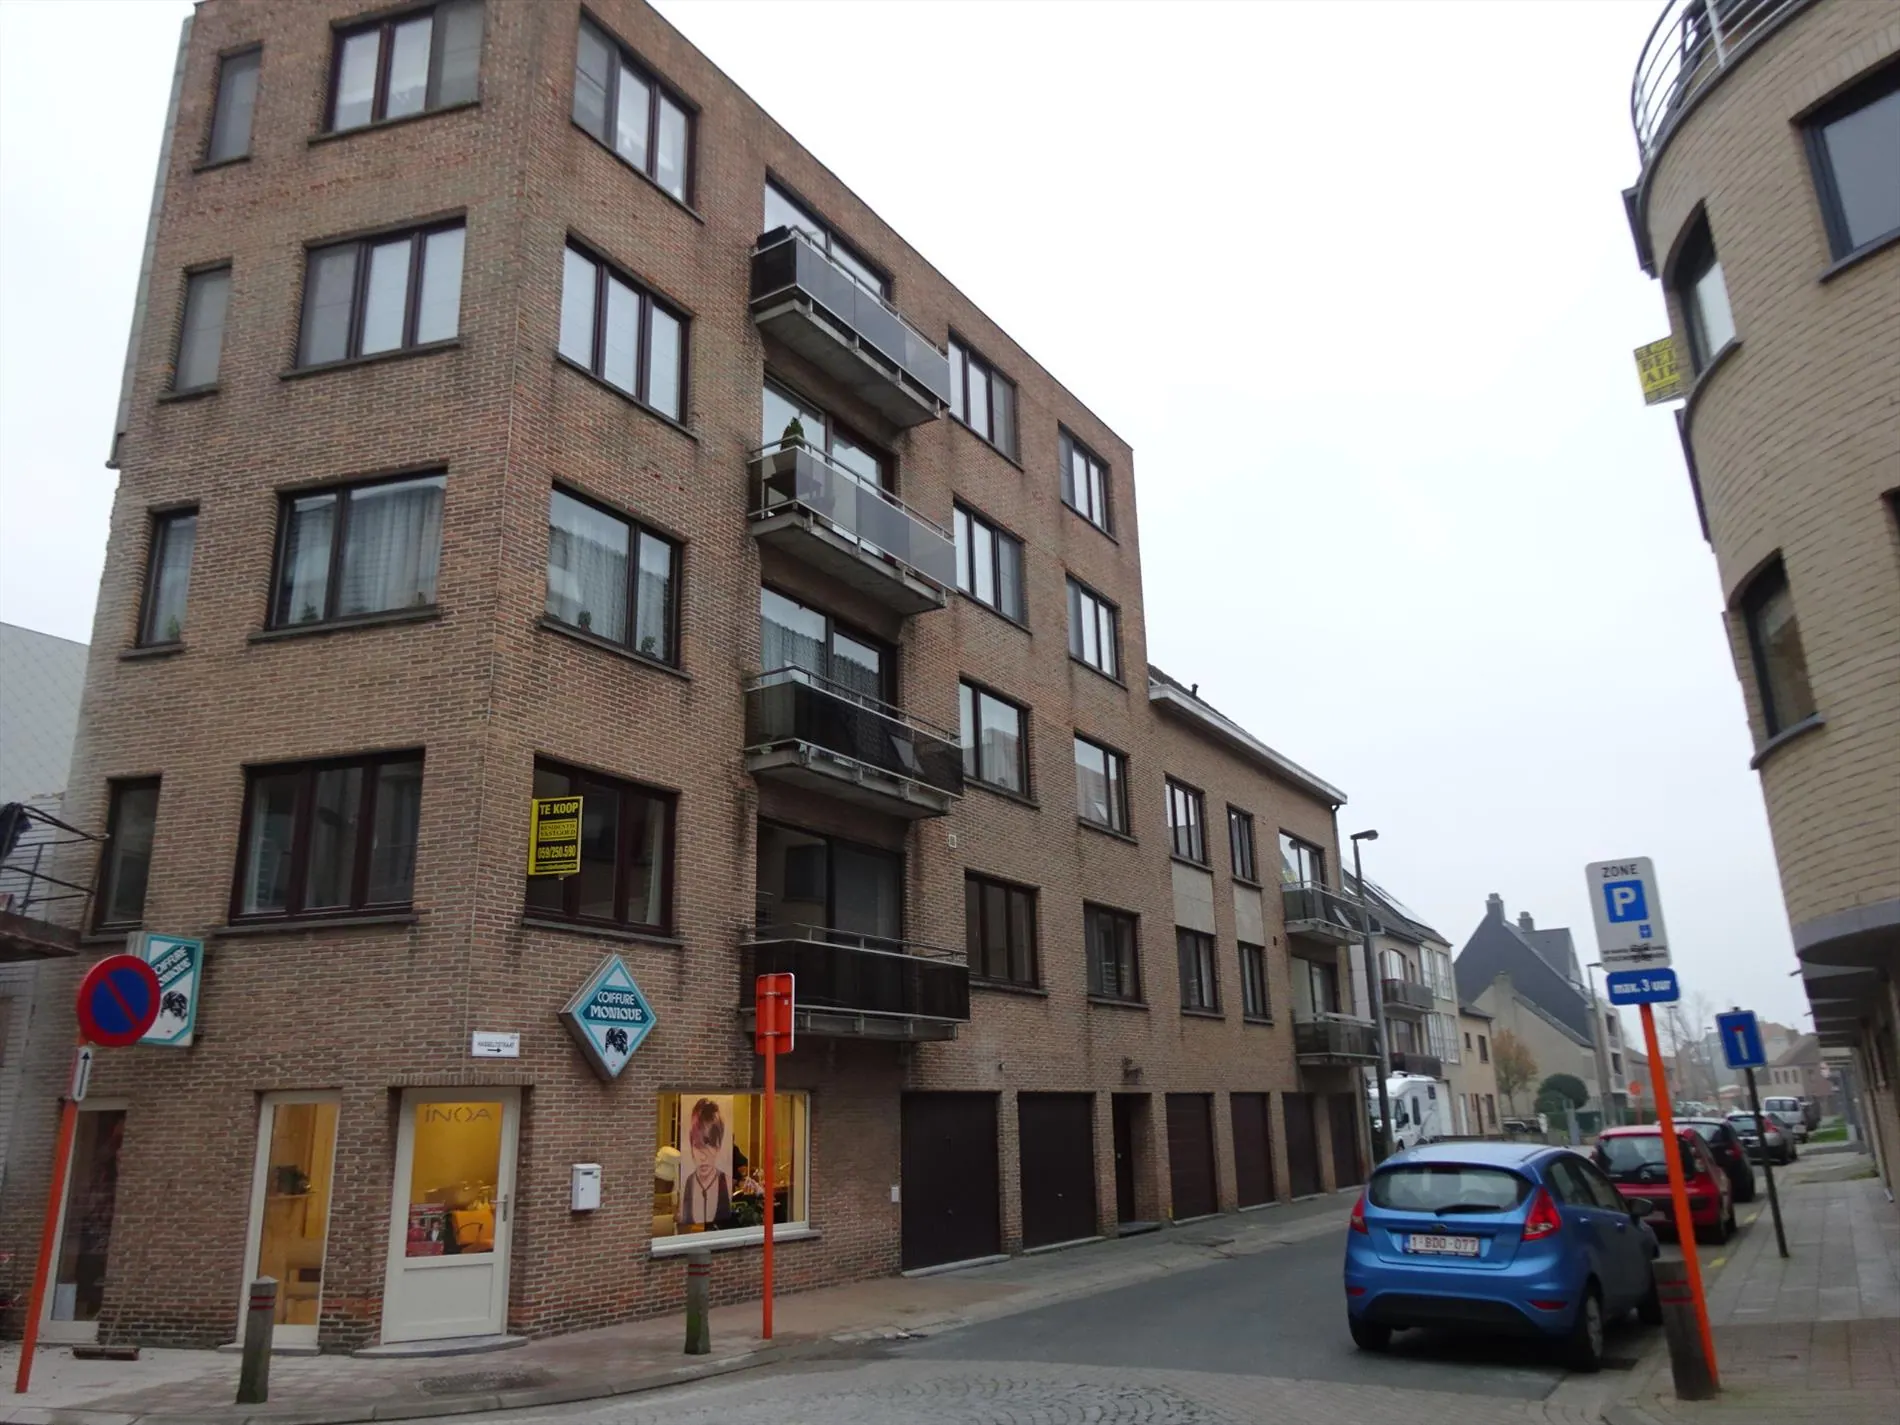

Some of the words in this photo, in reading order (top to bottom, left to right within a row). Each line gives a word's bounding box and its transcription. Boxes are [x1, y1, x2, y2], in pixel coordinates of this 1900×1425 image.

[540, 804, 551, 815] TE
[553, 802, 578, 814] KOOP
[1601, 863, 1640, 879] ZONE
[1612, 887, 1636, 918] P
[152, 945, 188, 975] OIFFURE
[1612, 982, 1642, 995] max.
[1641, 978, 1651, 992] 3
[1652, 979, 1672, 992] uur
[597, 991, 635, 1006] COIFFURE
[590, 1005, 643, 1021] MONIQUE
